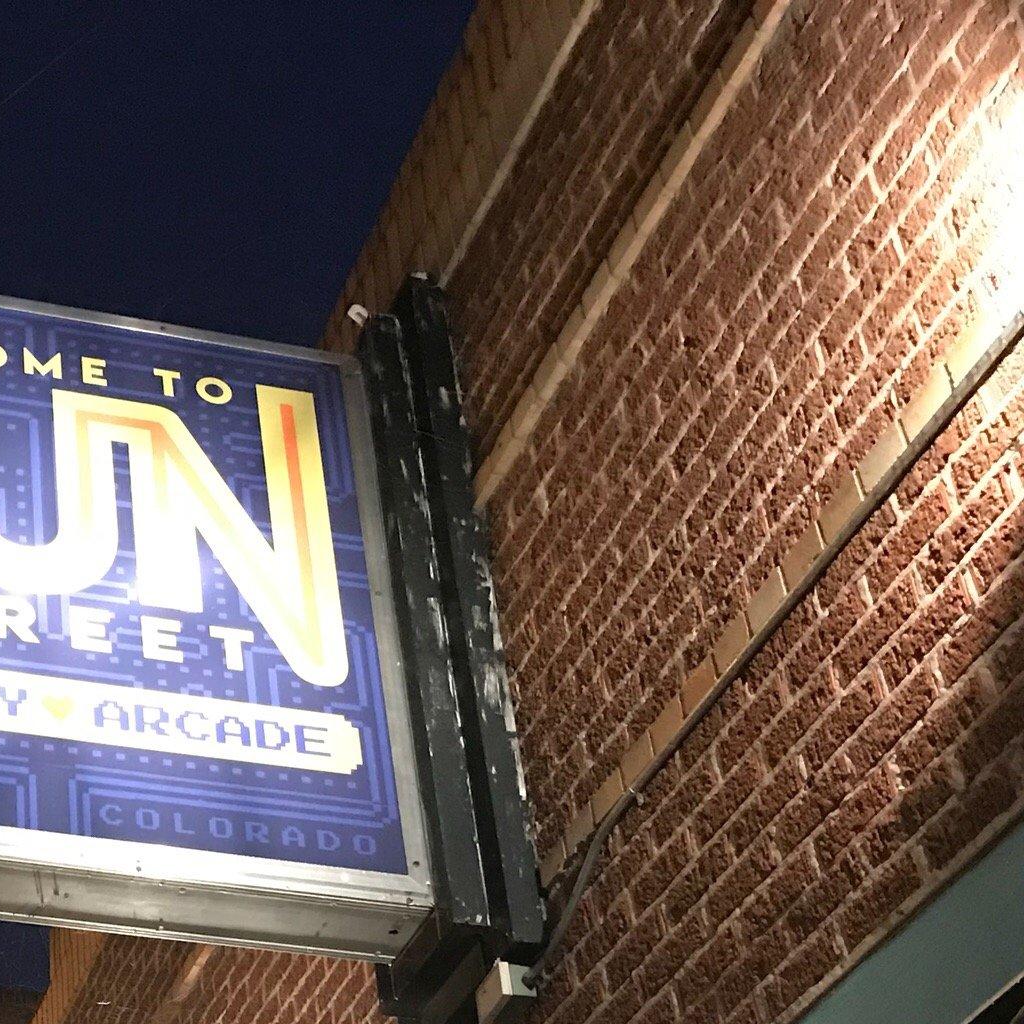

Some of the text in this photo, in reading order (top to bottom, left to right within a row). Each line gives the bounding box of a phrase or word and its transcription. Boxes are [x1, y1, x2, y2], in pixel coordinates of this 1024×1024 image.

[154, 367, 233, 405] TO
[93, 700, 333, 759] ARCADE
[99, 801, 379, 857] COLORADO
